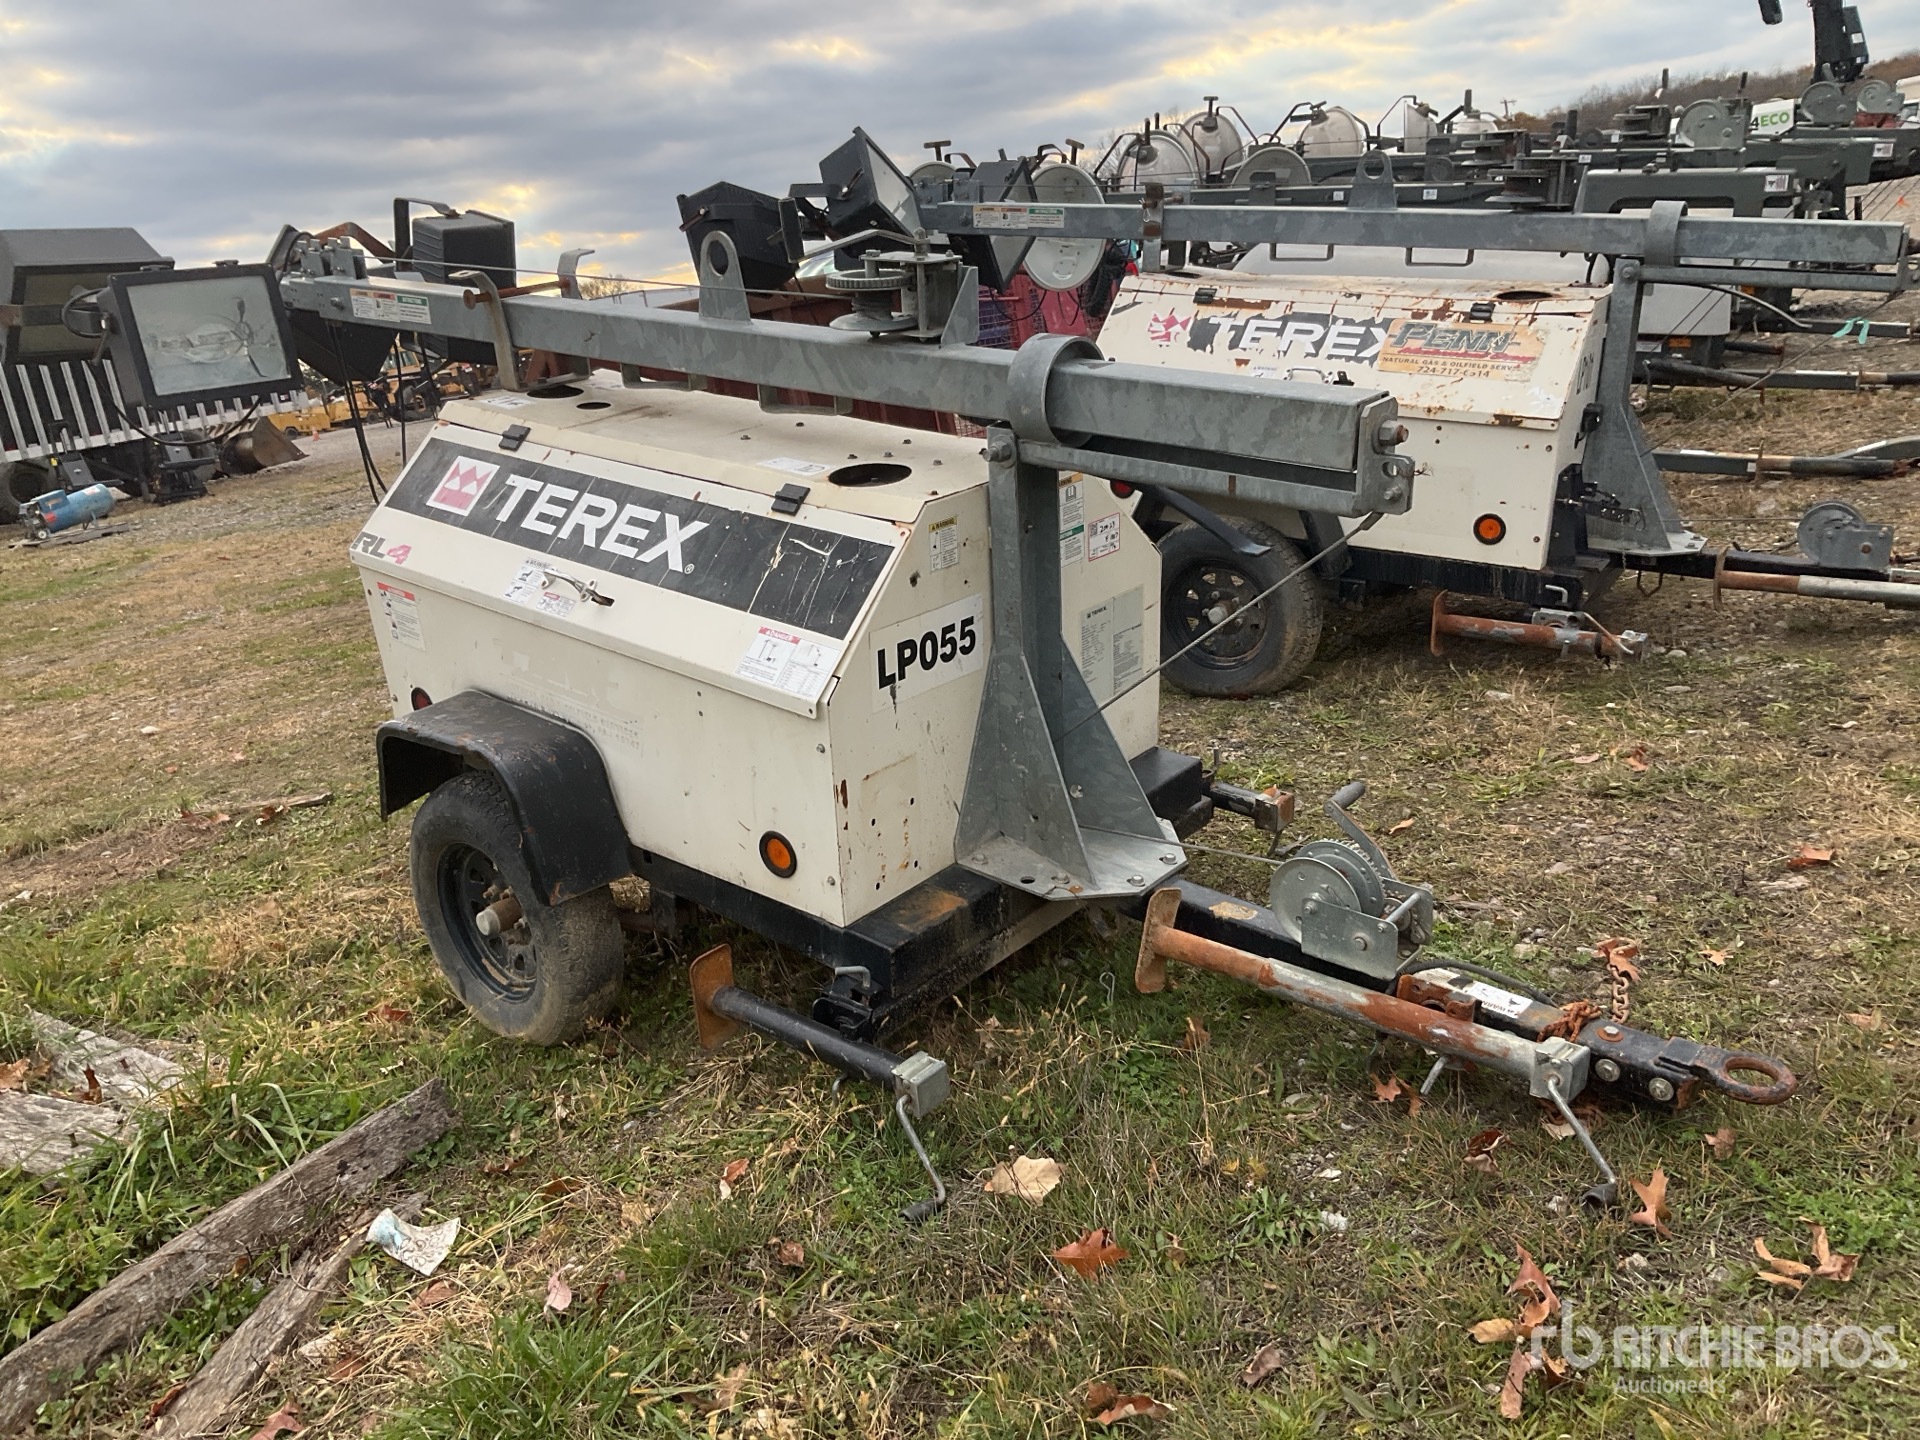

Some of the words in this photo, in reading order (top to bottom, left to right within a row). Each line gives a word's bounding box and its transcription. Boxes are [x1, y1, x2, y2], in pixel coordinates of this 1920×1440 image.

[1209, 316, 1388, 358] TEREX
[1391, 322, 1513, 353] PENN
[1382, 357, 1419, 365] NATURAL
[1450, 361, 1488, 371] OILFIELD
[495, 473, 711, 573] TEREX
[351, 530, 412, 565] RL4
[877, 615, 976, 690] LP055
